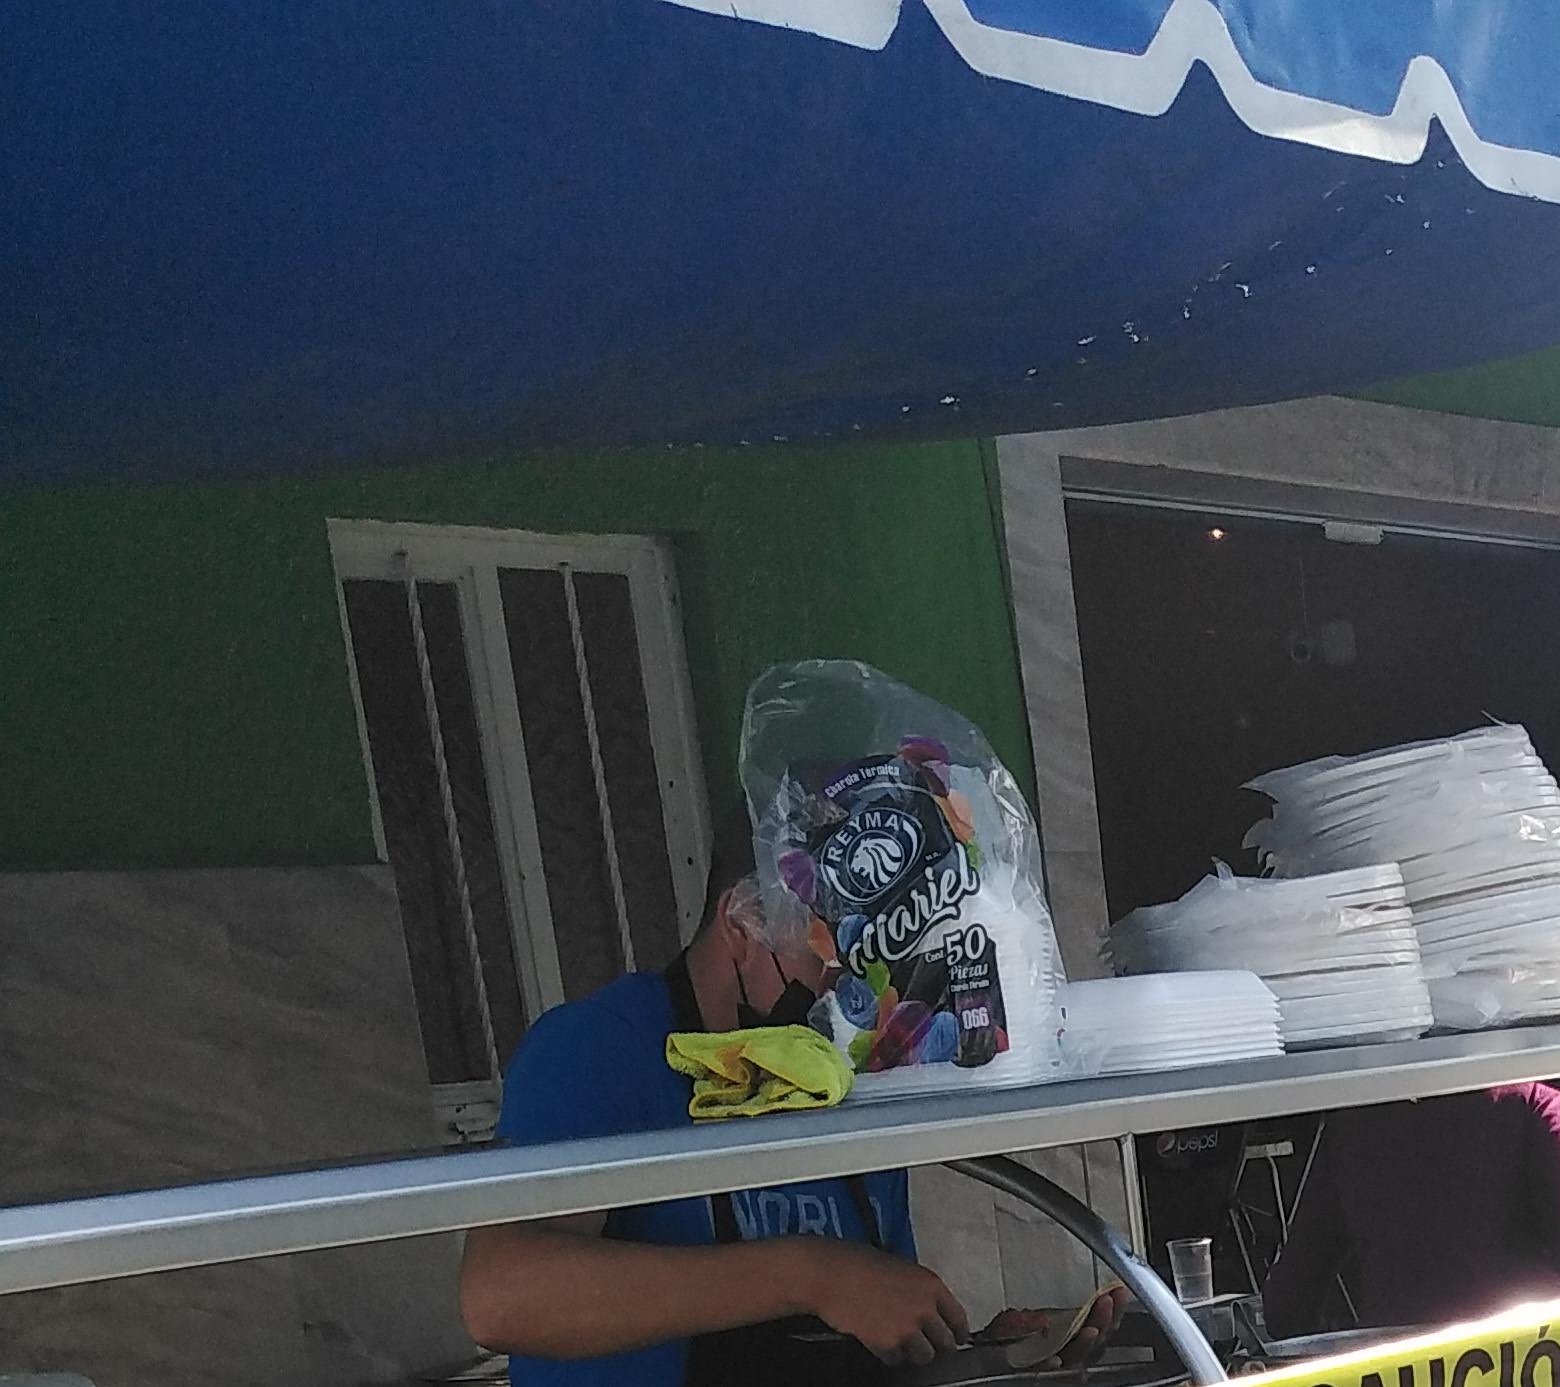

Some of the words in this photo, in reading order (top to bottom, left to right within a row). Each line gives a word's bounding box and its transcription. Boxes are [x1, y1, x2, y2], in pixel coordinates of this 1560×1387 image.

[826, 811, 900, 863] REYMA
[848, 842, 977, 976] Mariel
[945, 925, 986, 966] 50
[949, 963, 989, 981] Piezas
[1176, 1129, 1218, 1155] pepsi
